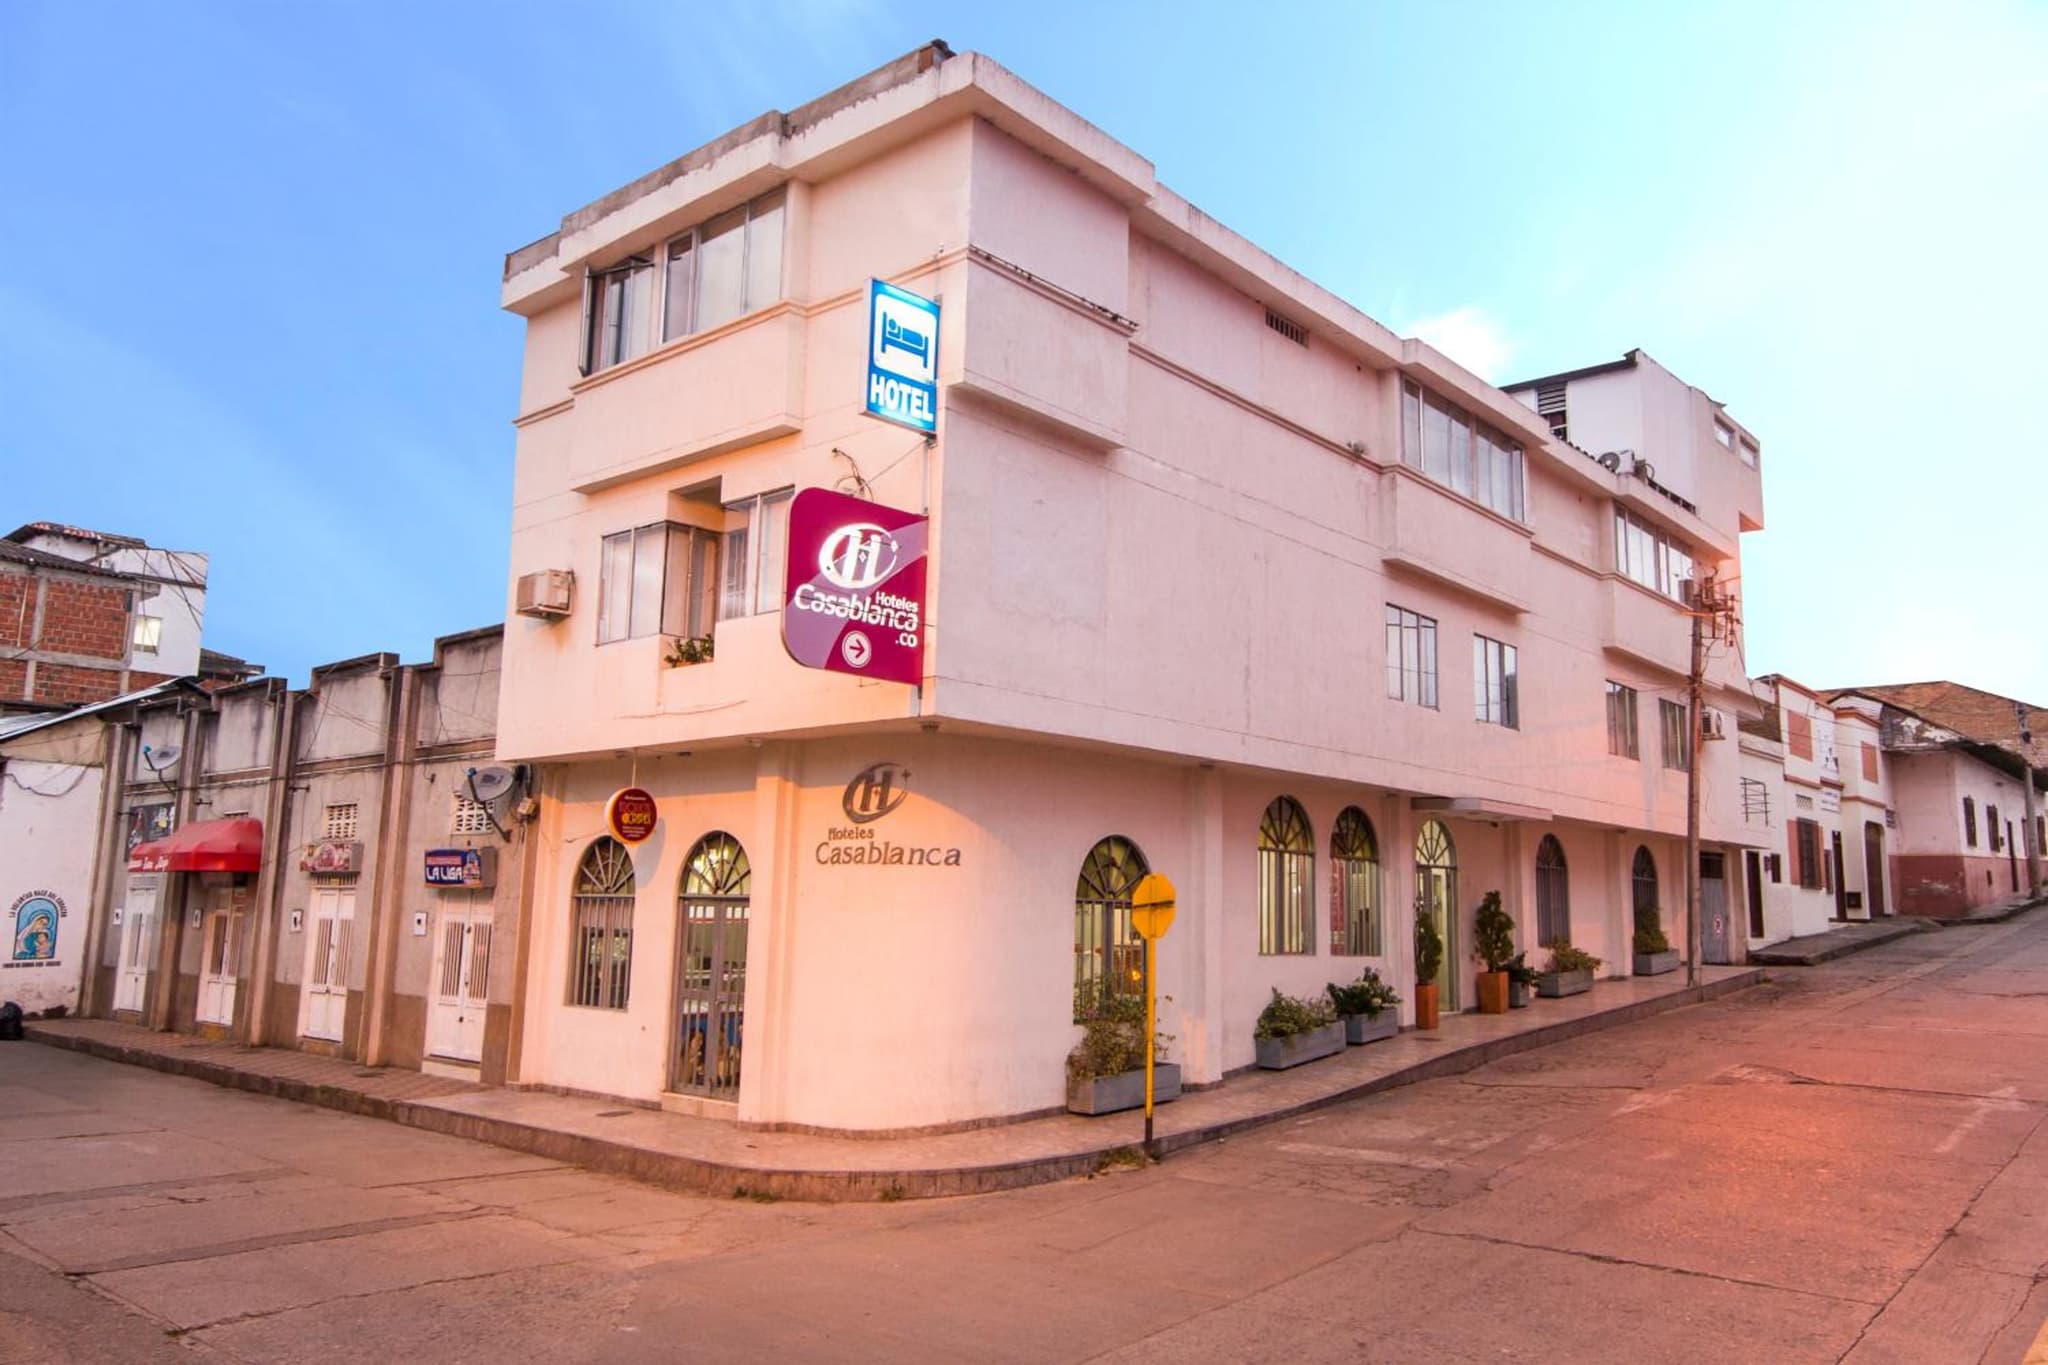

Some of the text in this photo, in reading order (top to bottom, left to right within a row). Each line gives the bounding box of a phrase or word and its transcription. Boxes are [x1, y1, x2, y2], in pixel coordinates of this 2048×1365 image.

[870, 373, 934, 422] HOTEL
[794, 583, 919, 632] Casablanca
[875, 591, 918, 613] Hoteles
[895, 633, 918, 648] .co
[828, 826, 875, 841] Hoteles
[815, 841, 962, 867] Casablanca
[426, 866, 463, 881] LA LIGA
